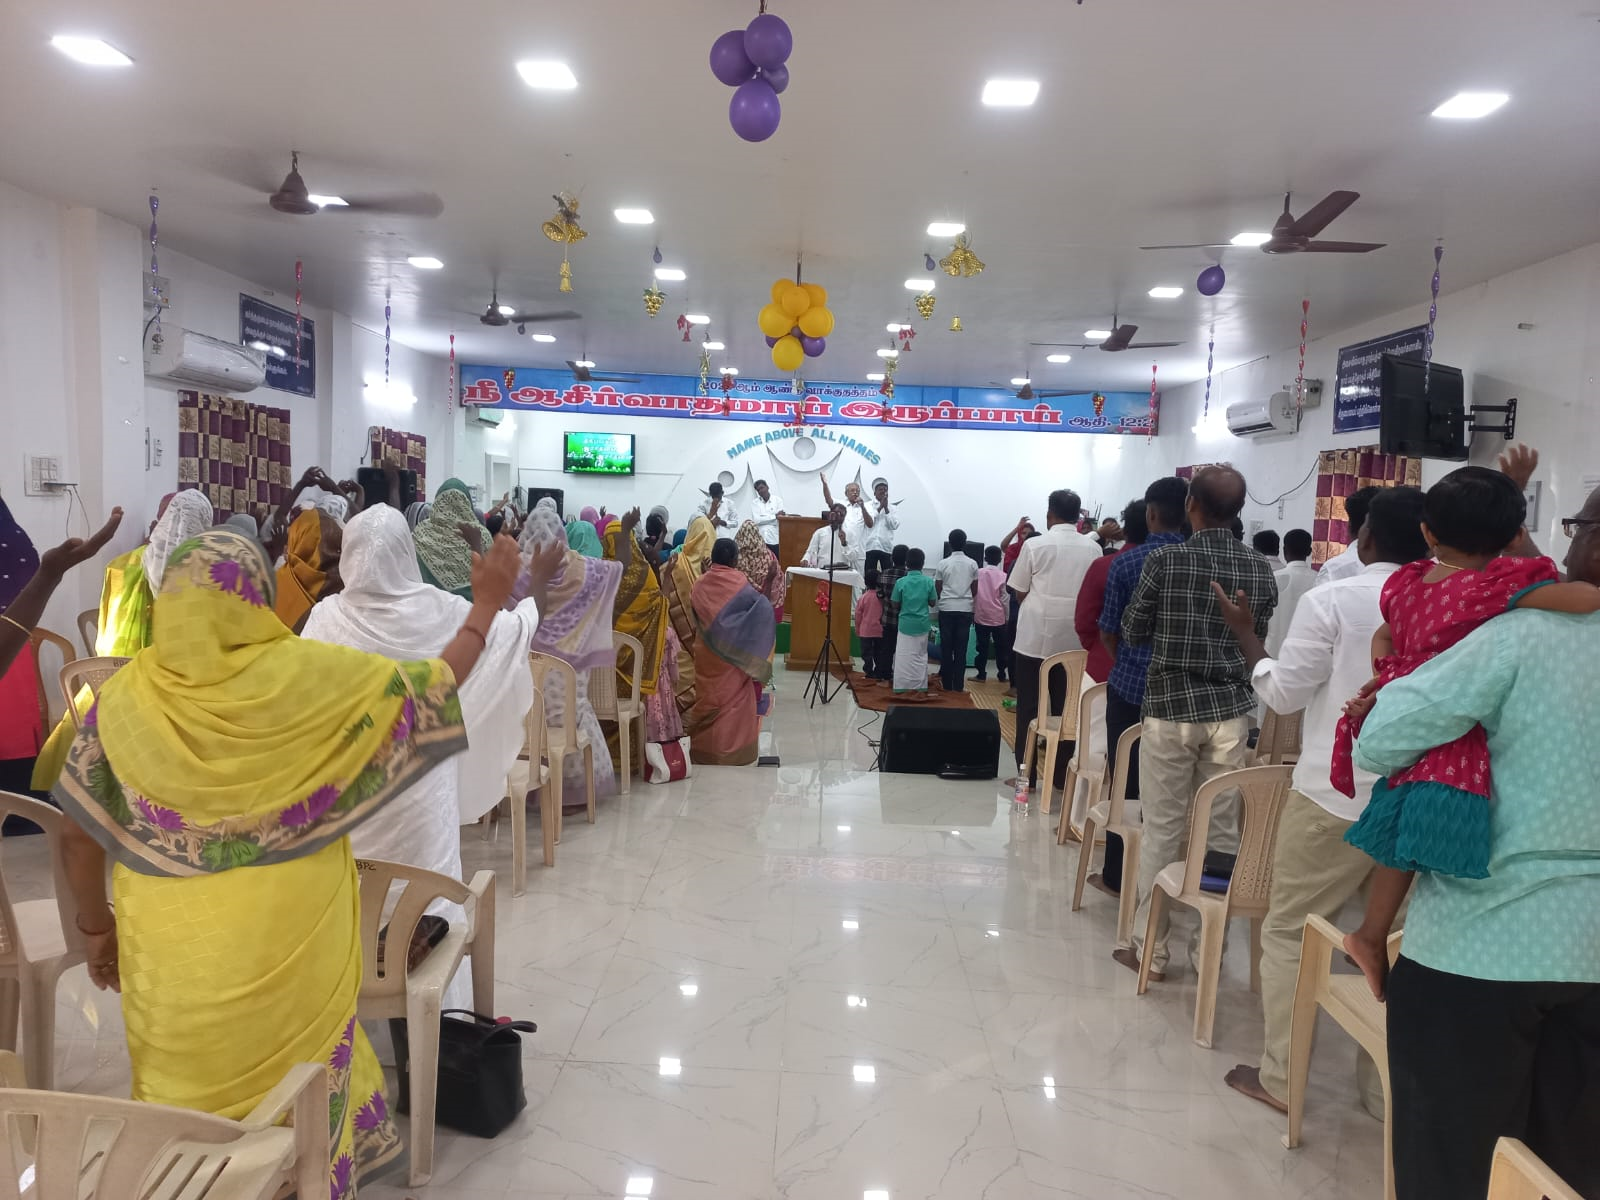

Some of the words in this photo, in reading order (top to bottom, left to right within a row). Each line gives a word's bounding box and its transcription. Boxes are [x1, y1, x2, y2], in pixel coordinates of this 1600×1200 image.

[463, 379, 501, 405] நீ
[839, 400, 1063, 424] இருப்பாய்
[726, 434, 763, 459] NAME
[765, 427, 804, 443] ABOVE
[811, 427, 836, 442] ALL
[838, 434, 881, 465] NAMES
